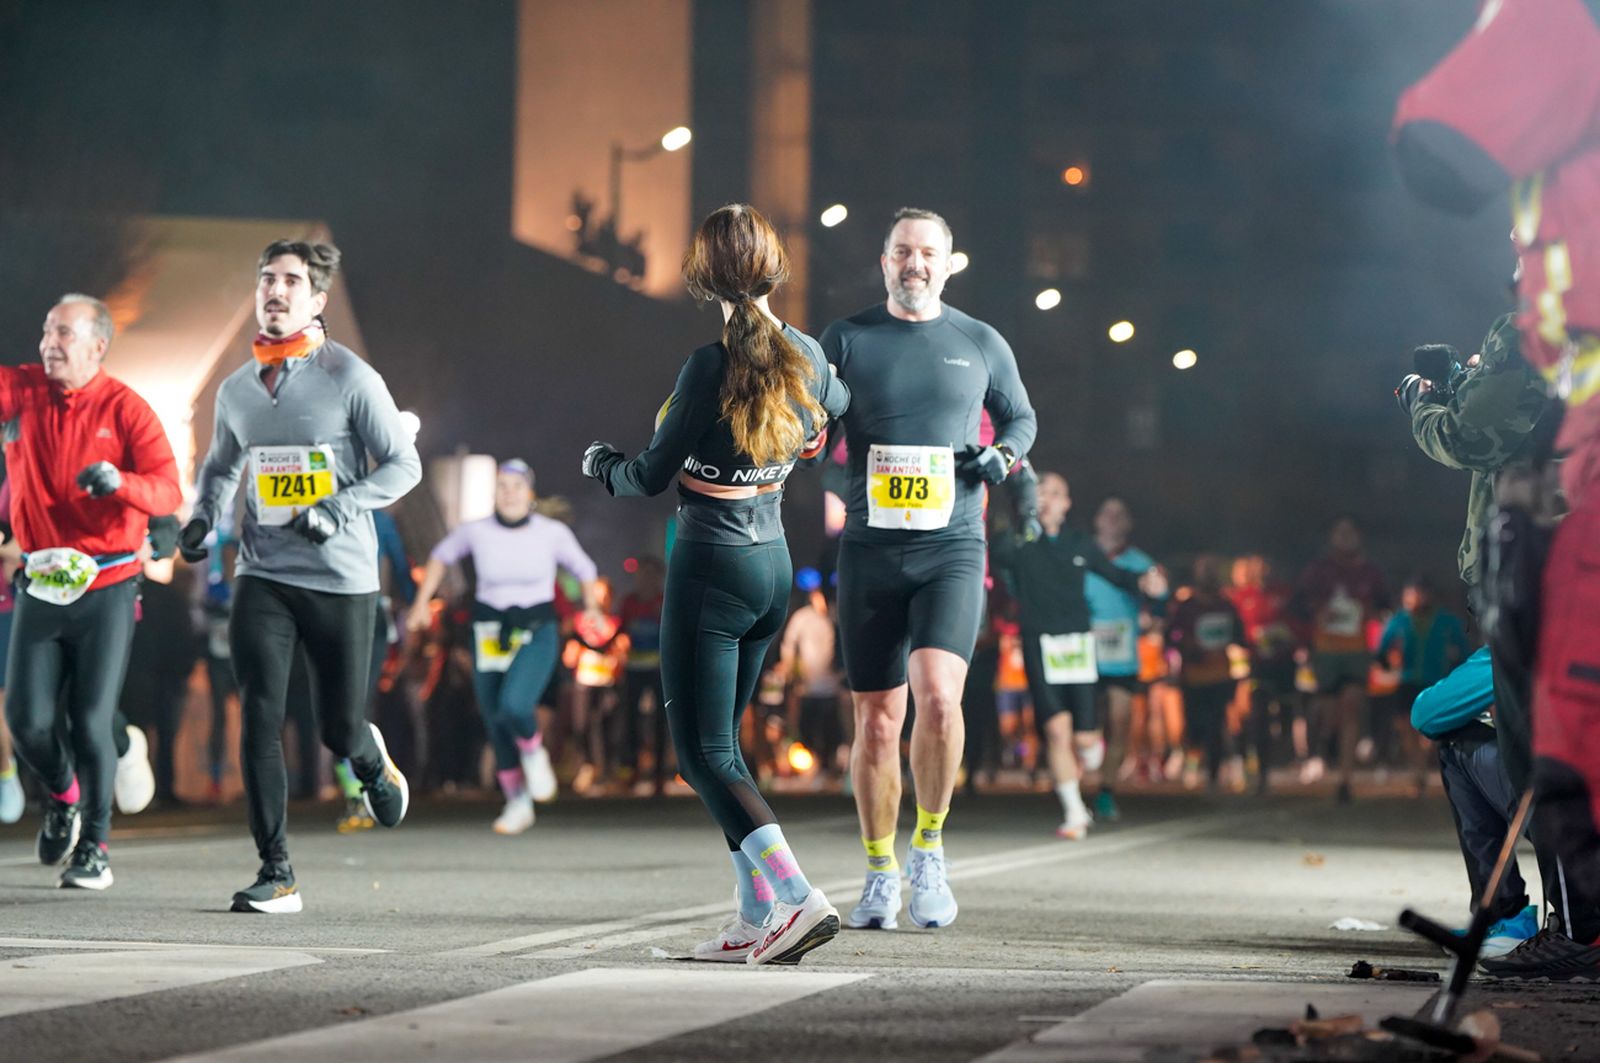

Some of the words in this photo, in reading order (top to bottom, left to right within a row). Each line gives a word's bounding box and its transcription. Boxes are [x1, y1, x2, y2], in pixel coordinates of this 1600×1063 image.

[731, 464, 777, 482] NIKE
[269, 474, 316, 497] 7241
[889, 476, 928, 500] 873
